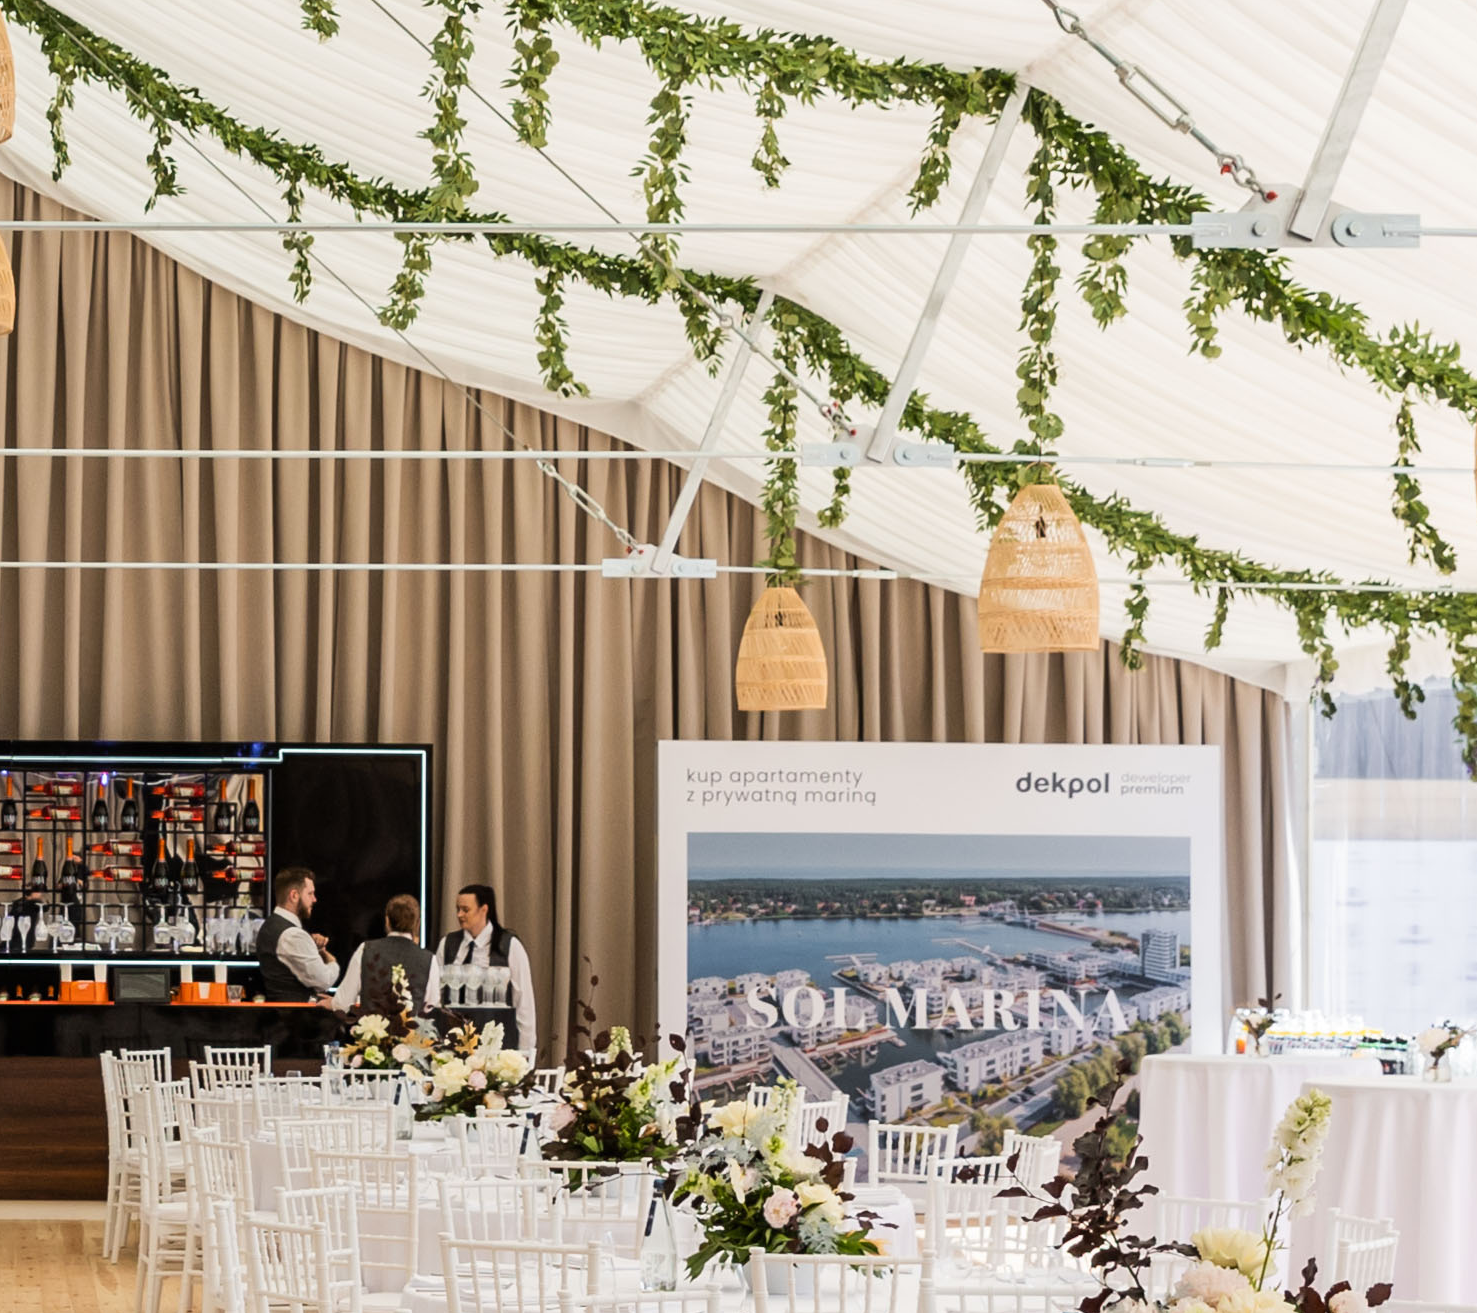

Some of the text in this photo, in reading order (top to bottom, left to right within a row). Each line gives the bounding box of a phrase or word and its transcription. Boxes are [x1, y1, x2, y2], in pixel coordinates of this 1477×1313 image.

[686, 768, 864, 788] kup apartamenty
[1015, 771, 1110, 799] dekpol
[1120, 772, 1192, 784] deweloper
[686, 787, 877, 807] z prywatną mariną
[1120, 784, 1185, 796] premium
[745, 985, 1132, 1032] SOL MARINA
